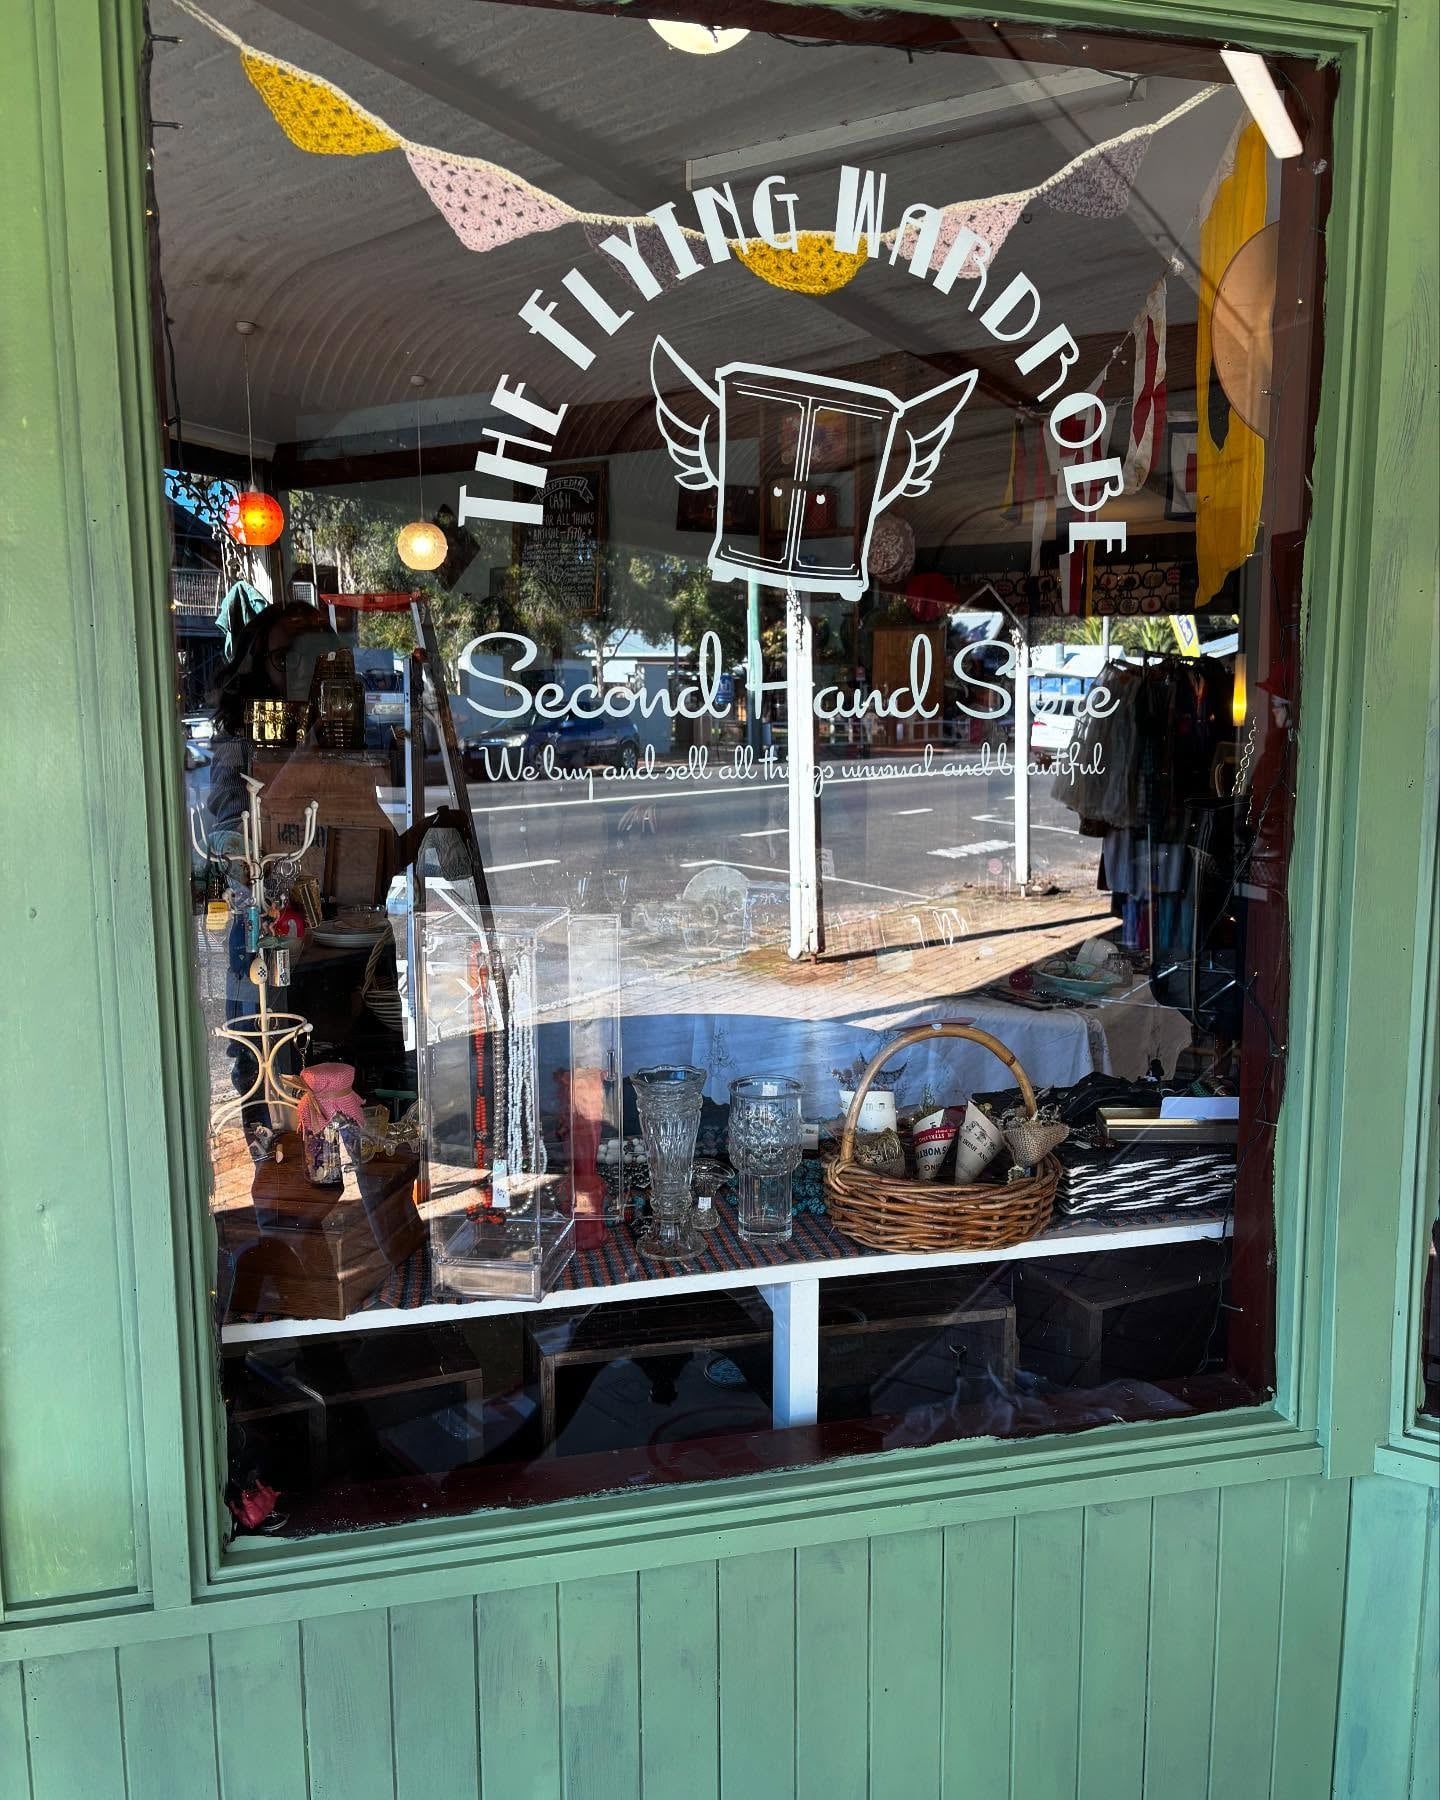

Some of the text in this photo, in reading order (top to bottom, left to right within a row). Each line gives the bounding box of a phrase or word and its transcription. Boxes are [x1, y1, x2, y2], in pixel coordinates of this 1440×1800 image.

[458, 165, 1128, 555] THE FLYING WARDROBE
[557, 513, 571, 526] ALL
[571, 511, 595, 526] THINGS
[458, 631, 731, 719] Second
[478, 742, 1106, 801] We buy and sell all thigs unusual and bautiful
